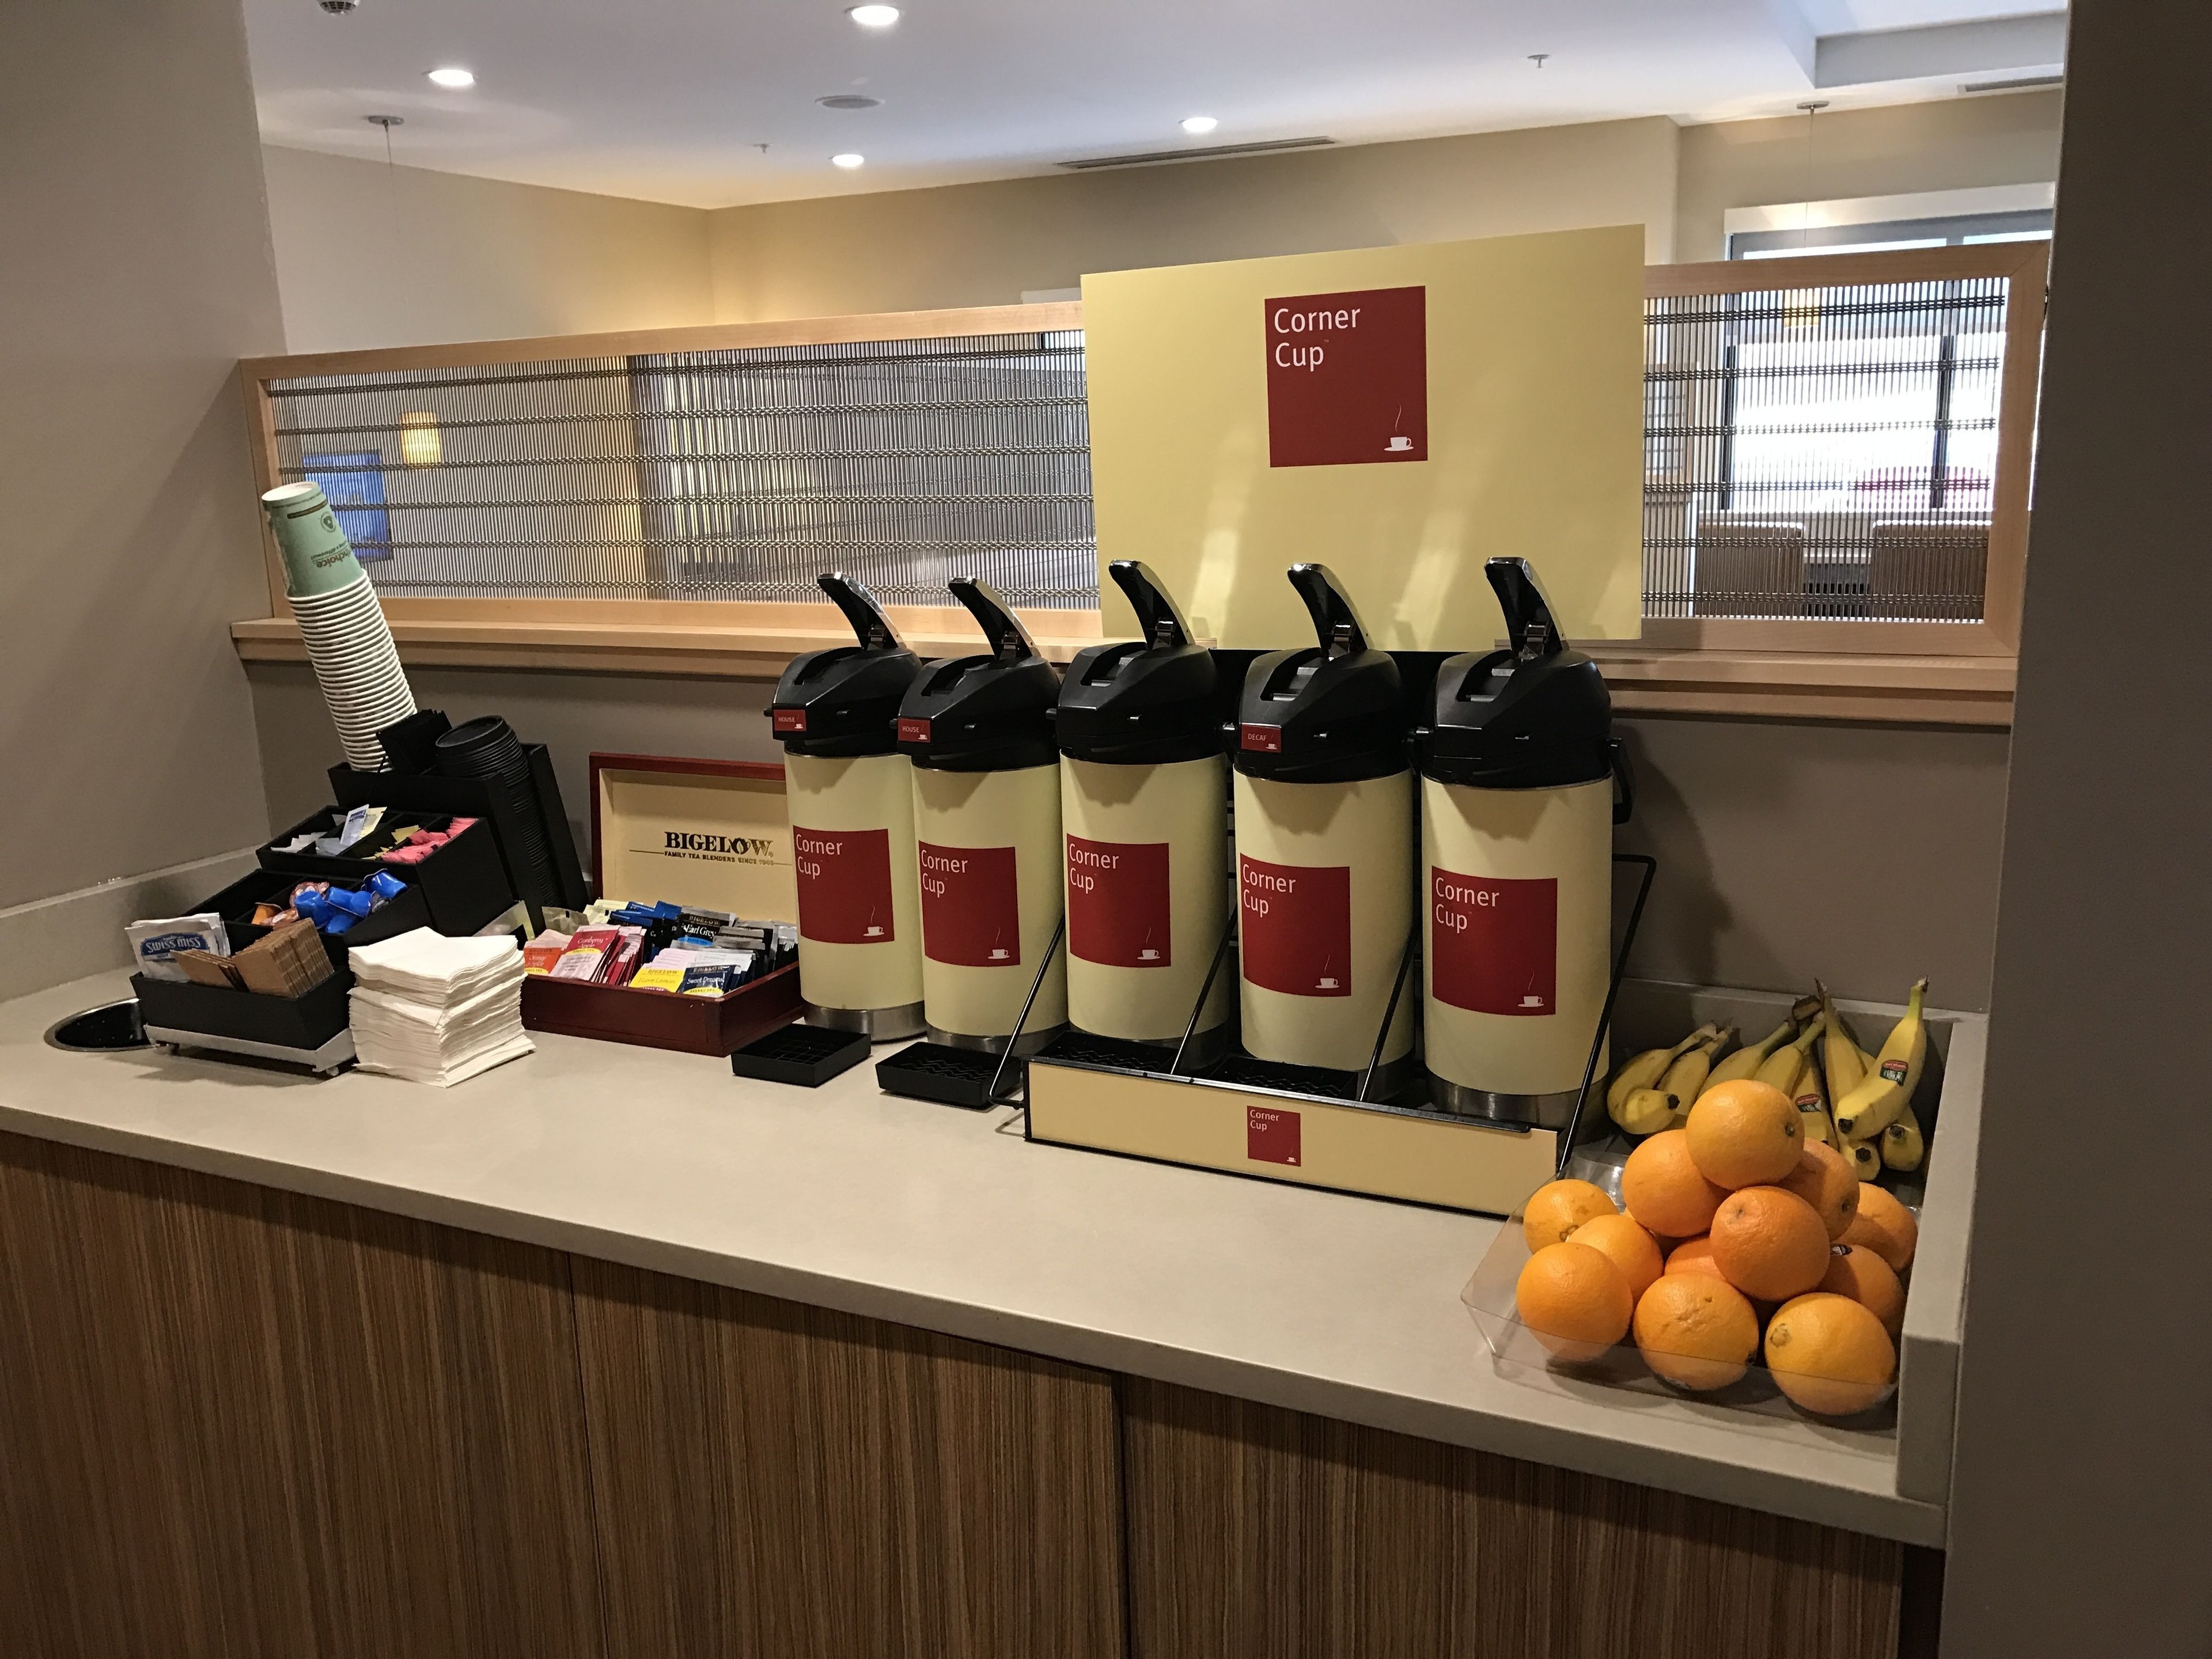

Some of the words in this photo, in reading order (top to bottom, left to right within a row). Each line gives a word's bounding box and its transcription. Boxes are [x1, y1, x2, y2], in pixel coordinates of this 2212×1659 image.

[1274, 308, 1361, 334] Corner
[1275, 342, 1324, 372] Cup
[1248, 733, 1267, 741] DECAF
[664, 831, 773, 857] BIGELOW
[796, 834, 843, 856] Corner
[1069, 843, 1120, 870] Corner
[702, 854, 736, 863] BLENDERS
[797, 856, 821, 880] Cup
[921, 849, 968, 874] Corner
[922, 873, 945, 898] Cup
[1069, 868, 1094, 895] Cup
[1243, 863, 1297, 893] Corner
[1244, 889, 1269, 918] Cup
[1435, 877, 1500, 907] Corner
[1435, 903, 1468, 934] Cup
[577, 936, 604, 945] Cranberry
[699, 926, 717, 939] Grey
[1249, 1109, 1279, 1121] Corner
[1250, 1120, 1267, 1132] Cup
